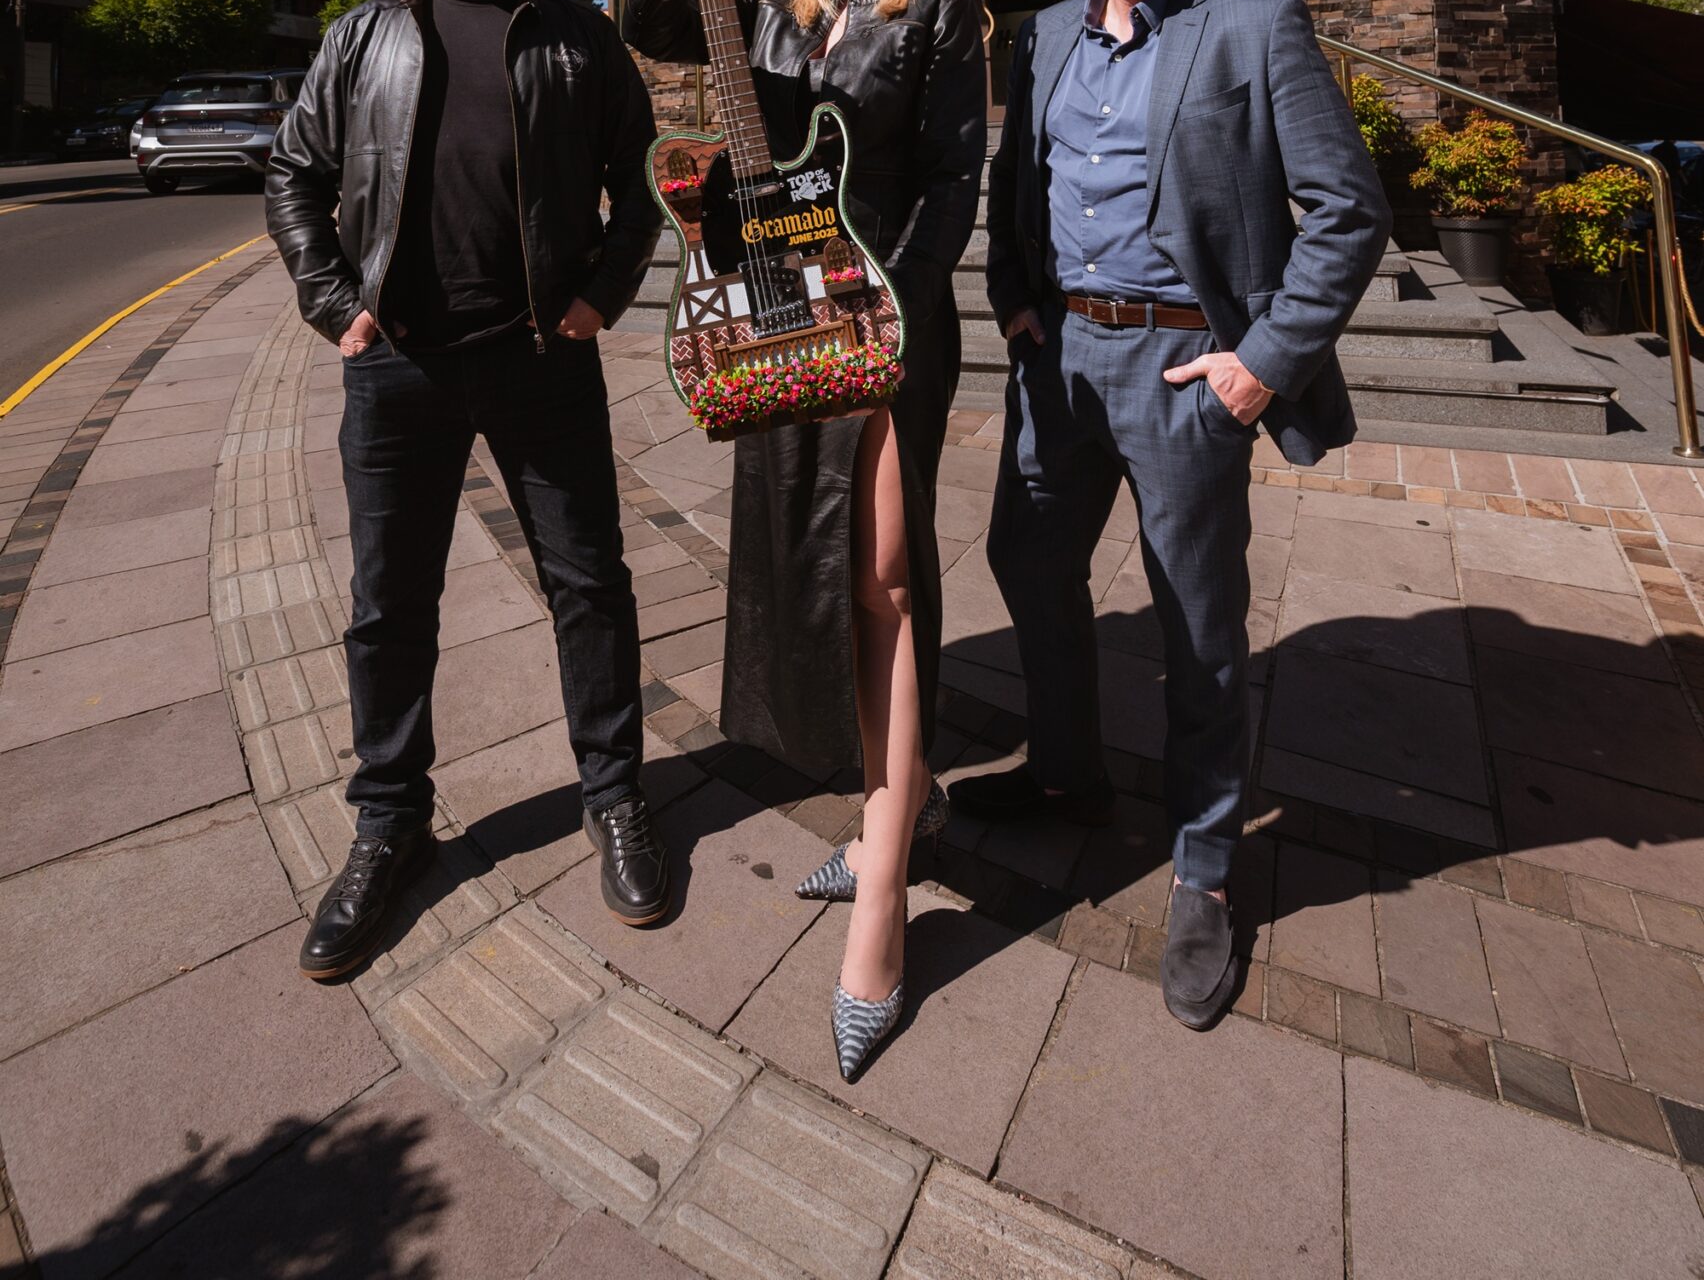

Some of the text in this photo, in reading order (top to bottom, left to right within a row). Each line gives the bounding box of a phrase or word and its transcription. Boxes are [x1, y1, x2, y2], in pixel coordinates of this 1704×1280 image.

[787, 168, 825, 189] TOP OF
[817, 172, 832, 181] THE
[741, 203, 836, 243] Gramado
[788, 226, 839, 246] JUNE 2025
